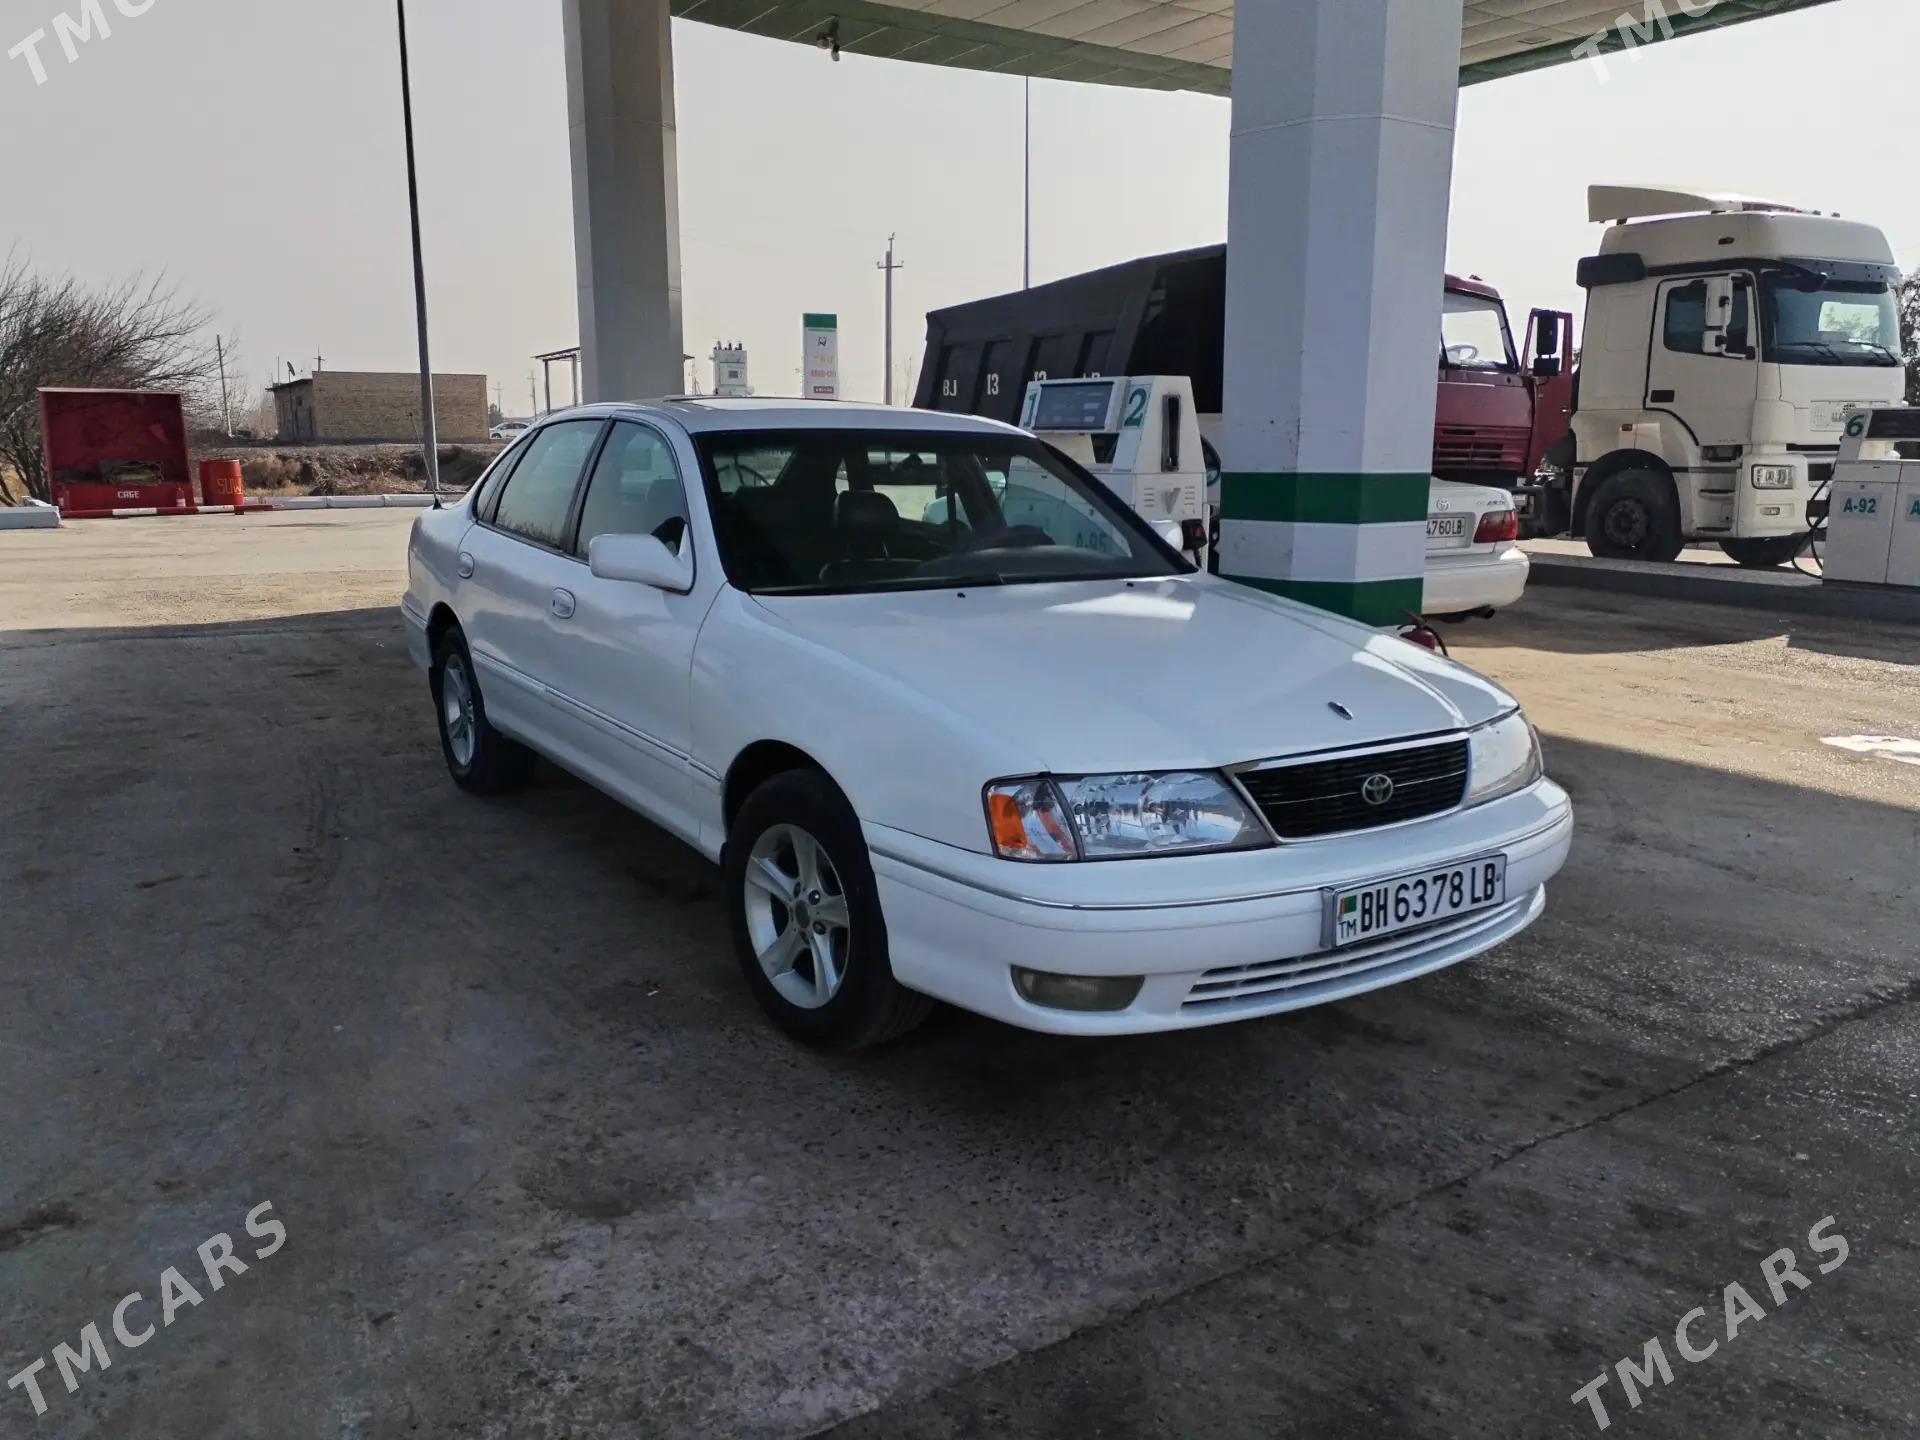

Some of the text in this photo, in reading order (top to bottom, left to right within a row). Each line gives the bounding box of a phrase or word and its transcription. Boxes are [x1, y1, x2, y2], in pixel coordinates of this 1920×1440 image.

[1023, 392, 1038, 428] 1
[1124, 388, 1147, 427] 2
[1846, 415, 1865, 437] 6
[1843, 498, 1876, 513] A-92
[1339, 918, 1358, 940] TM
